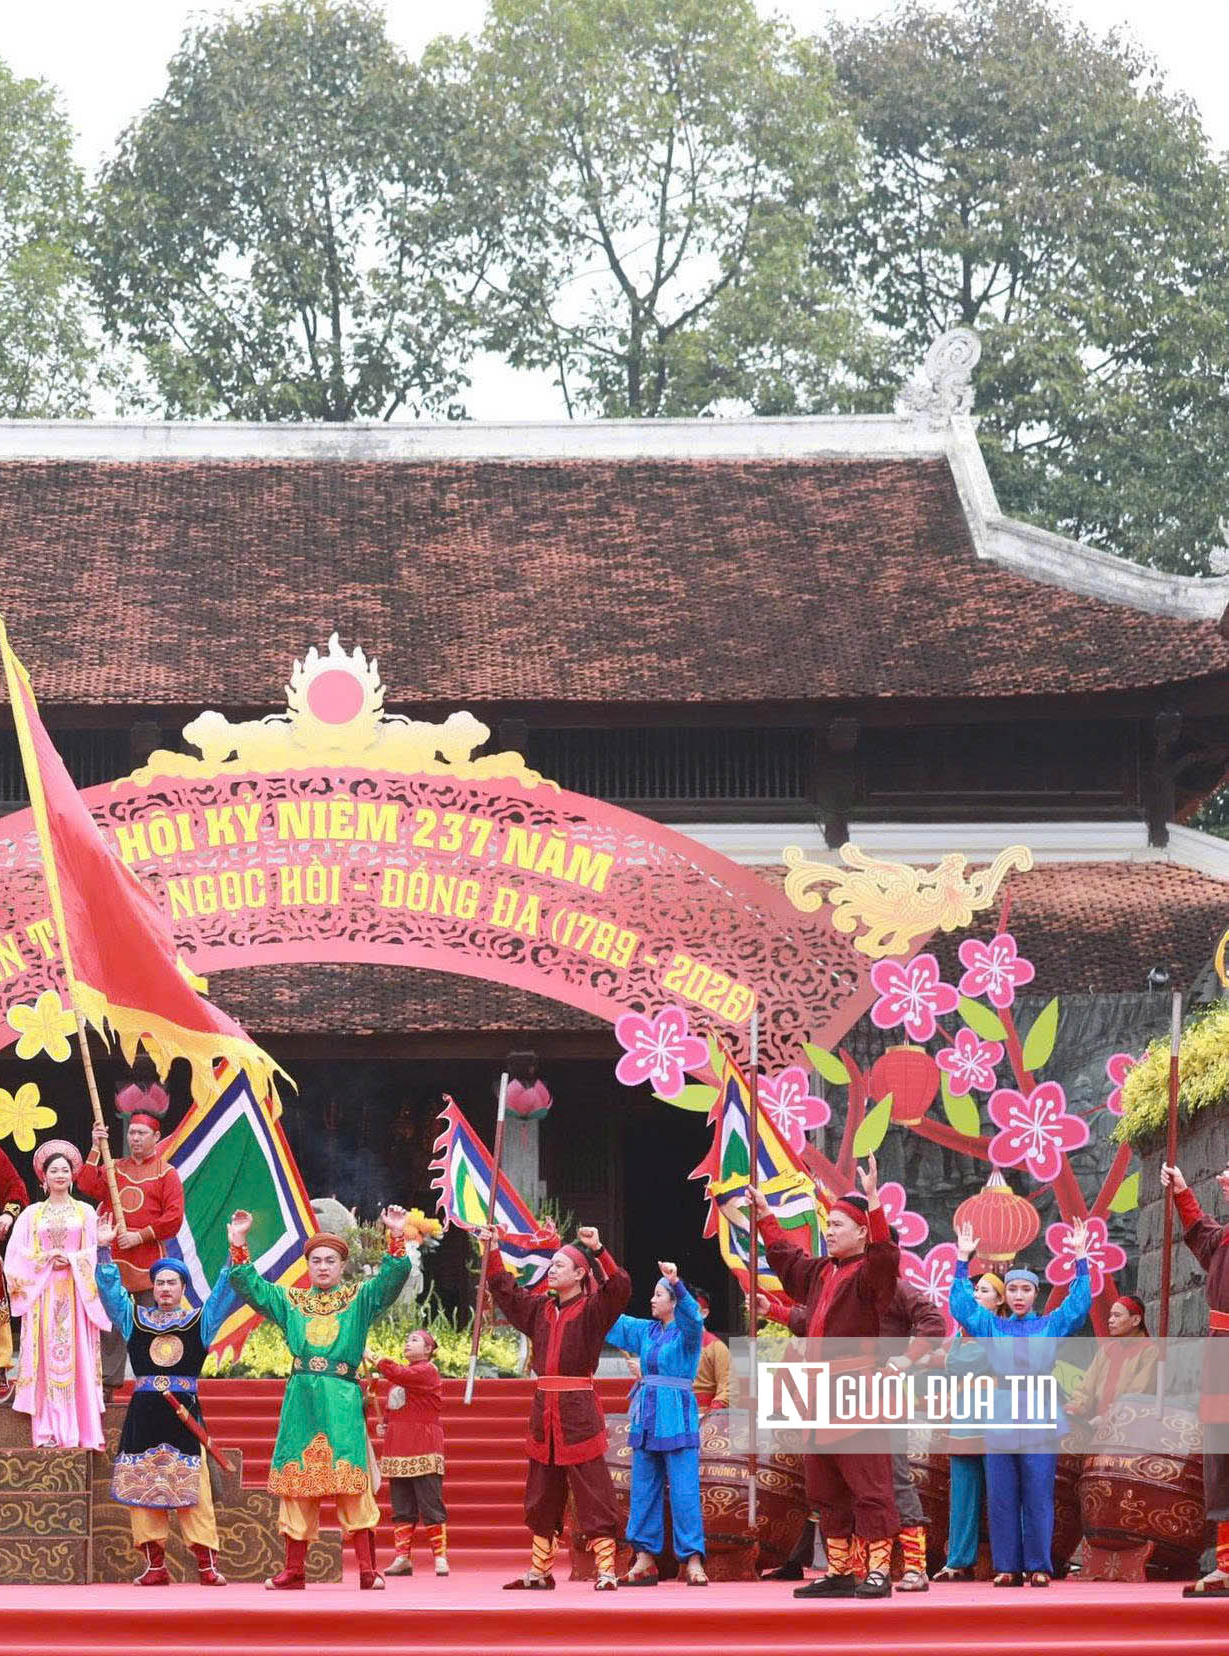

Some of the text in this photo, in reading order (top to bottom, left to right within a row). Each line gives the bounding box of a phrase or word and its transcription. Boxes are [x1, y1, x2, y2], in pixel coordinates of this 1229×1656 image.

[115, 793, 614, 893] HỘI KỶ NIỆM 237 NĂM
[166, 868, 267, 920] NGỌC
[279, 855, 341, 906] HỒI
[379, 861, 481, 920] ĐỐNG
[489, 886, 540, 937] ĐA
[551, 907, 638, 969] (1789
[662, 954, 756, 1024] 2026)
